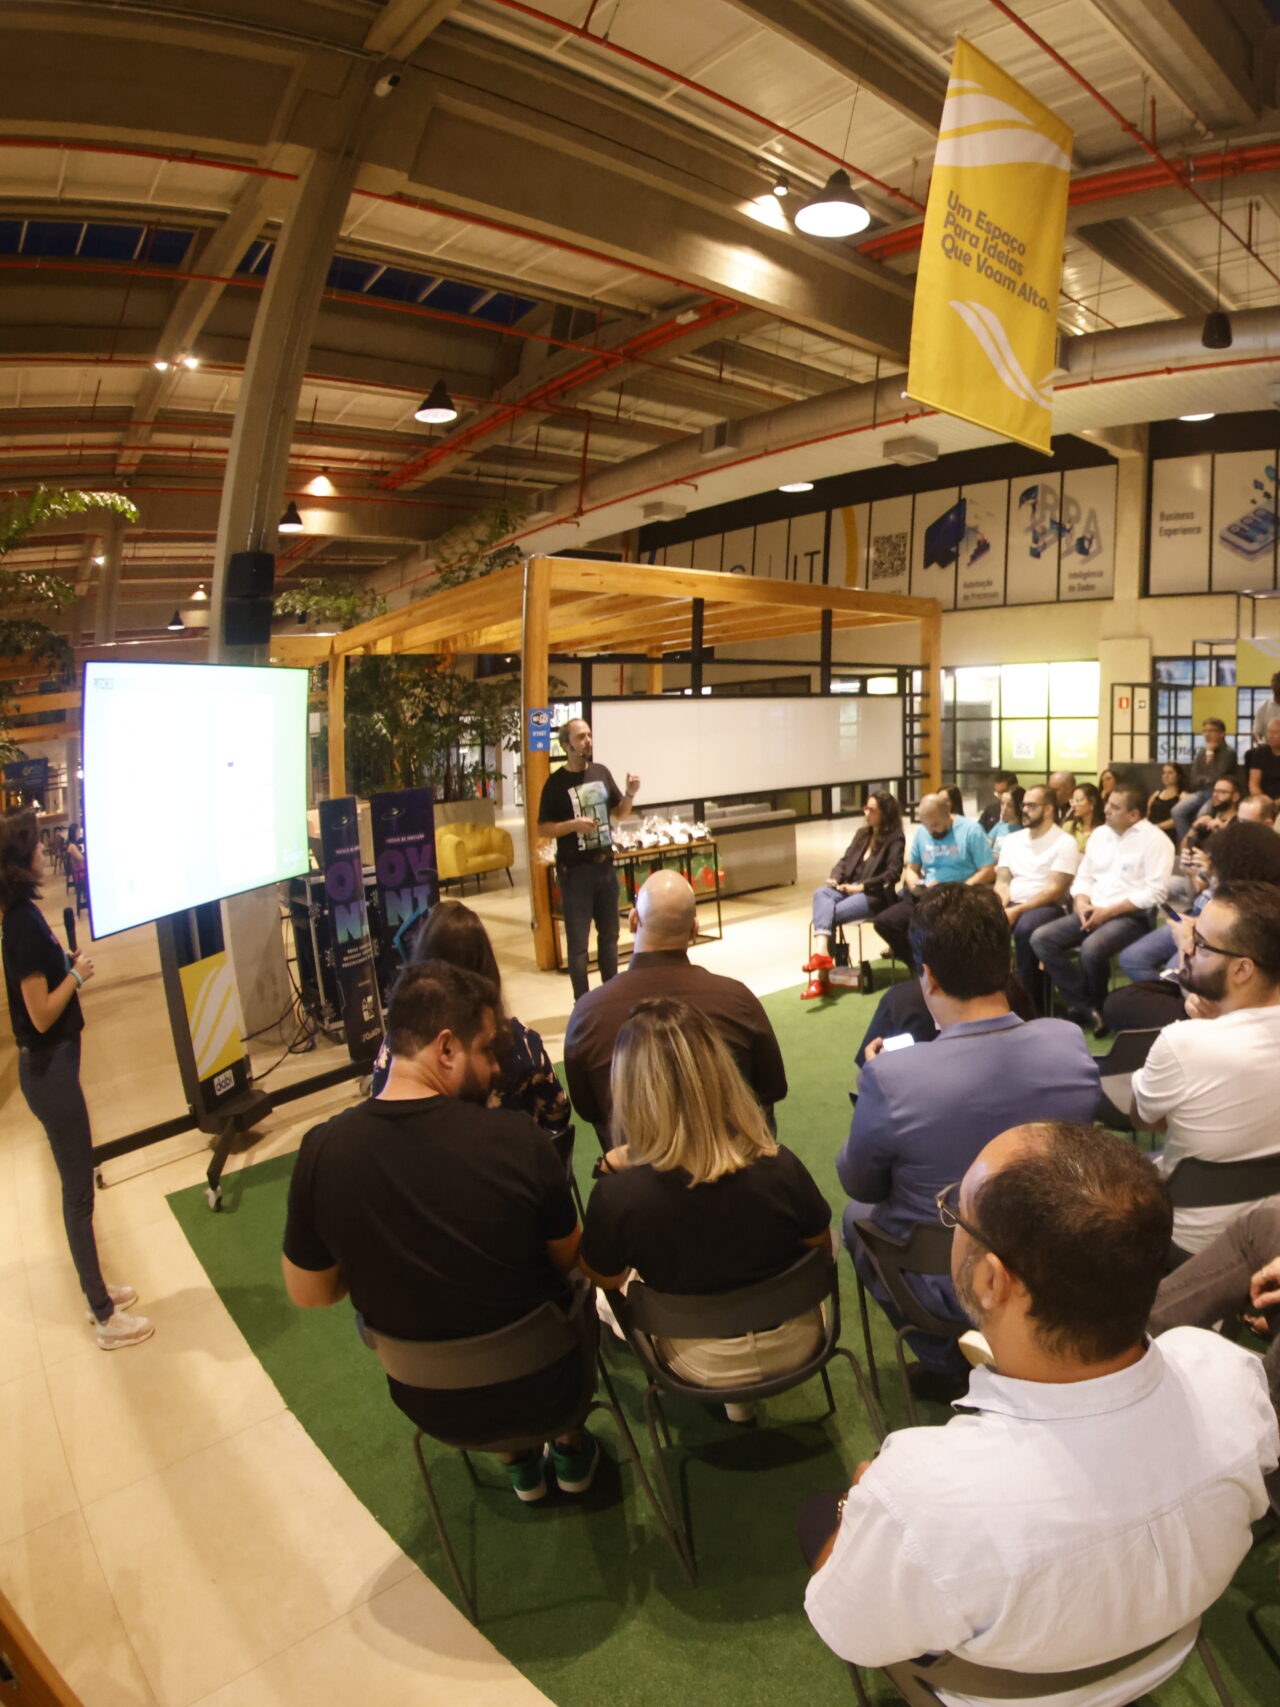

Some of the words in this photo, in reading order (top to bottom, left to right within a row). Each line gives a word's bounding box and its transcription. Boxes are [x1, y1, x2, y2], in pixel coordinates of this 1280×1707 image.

[944, 211, 980, 251] Para
[982, 235, 1024, 277] Ideias
[947, 190, 972, 223] Um
[974, 209, 1026, 257] Espaço
[941, 233, 972, 268] Que
[976, 252, 1016, 294] Voam
[1018, 281, 1050, 312] Alto.
[1159, 526, 1202, 538] Experience
